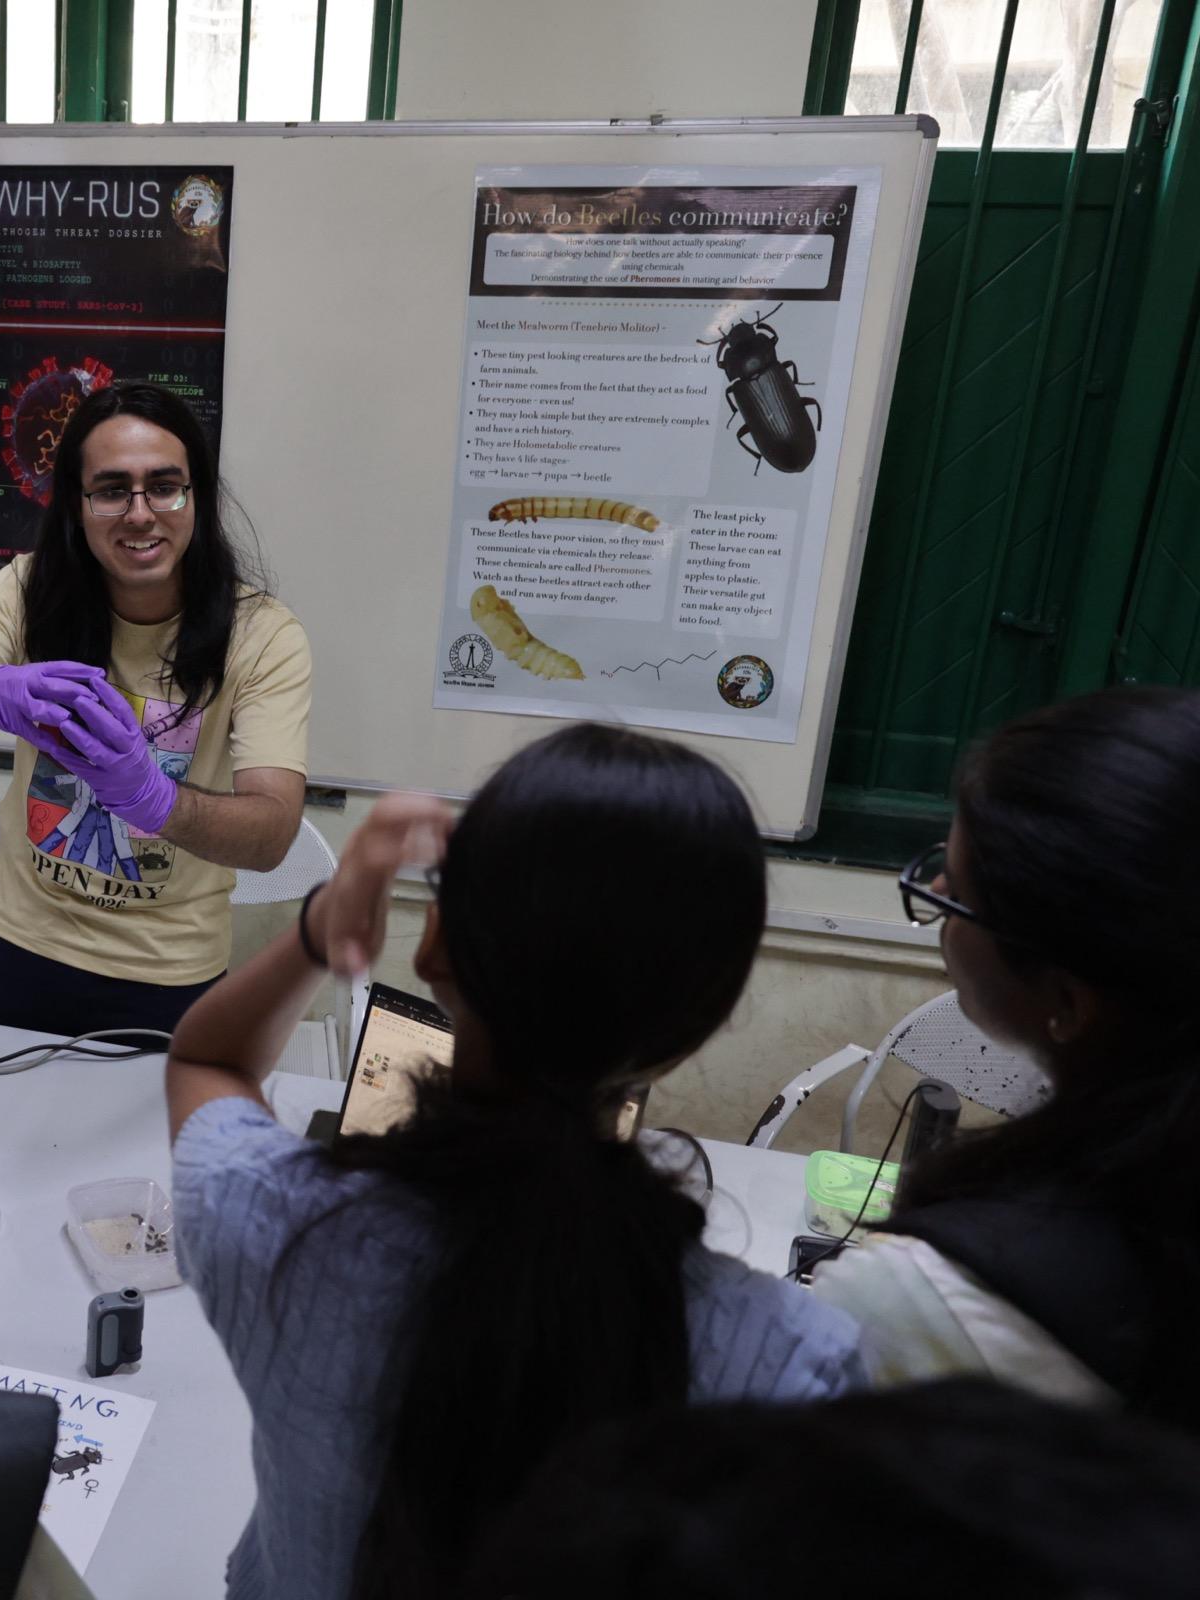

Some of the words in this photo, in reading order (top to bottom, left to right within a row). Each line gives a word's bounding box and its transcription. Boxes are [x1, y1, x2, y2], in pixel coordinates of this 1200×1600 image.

[482, 203, 537, 226] How
[543, 204, 572, 226] do
[578, 203, 662, 226] Beetles
[668, 203, 848, 226] communicate?
[55, 228, 100, 238] THREAT
[109, 229, 162, 239] DOSSIER
[32, 260, 81, 269] BIOSAFETY
[6, 274, 54, 283] PATHOGENS
[59, 275, 92, 284] LOGGED
[477, 319, 499, 329] Meet
[500, 320, 516, 330] the
[518, 320, 568, 330] Mealworm
[570, 321, 618, 332] (Tenebrio
[620, 322, 660, 332] Molitor)
[482, 348, 507, 358] These
[508, 351, 524, 362] tiny
[526, 351, 545, 362] pest
[547, 351, 581, 362] looking
[643, 353, 658, 362] the
[660, 353, 698, 363] bedrock
[479, 364, 500, 373] farm
[480, 379, 502, 388] Their
[559, 381, 581, 391] from
[583, 381, 597, 391] the
[599, 382, 615, 391] fact
[617, 383, 635, 392] that
[637, 383, 655, 393] they
[685, 384, 707, 395] food
[477, 393, 490, 402] for
[561, 396, 574, 405] us!
[478, 408, 497, 417] They
[499, 412, 517, 421] may
[519, 410, 538, 419] look
[540, 410, 569, 423] simple
[571, 411, 585, 421] but
[587, 412, 606, 424] they
[624, 414, 668, 424] extremely
[670, 416, 710, 428] complex
[474, 423, 491, 432] and
[492, 424, 512, 433] have
[521, 425, 539, 434] rich
[475, 437, 494, 449] They
[512, 439, 577, 450] Holometabolic
[578, 443, 620, 452] creatures
[474, 452, 493, 461] They
[495, 453, 515, 462] have
[524, 454, 538, 463] life
[469, 469, 485, 479] egg
[500, 468, 529, 478] larvae
[544, 472, 568, 482] pupa
[583, 471, 611, 482] beetle
[694, 509, 711, 519] The
[714, 510, 737, 521] least
[738, 512, 766, 525] picky
[472, 527, 496, 537] These
[498, 528, 529, 538] Beetles
[531, 530, 552, 540] have
[553, 534, 576, 544] poor
[620, 535, 639, 547] they
[690, 527, 716, 536] eater
[729, 528, 745, 537] the
[747, 532, 777, 540] room:
[476, 543, 536, 554] communicate
[537, 546, 550, 555] via
[552, 547, 596, 558] chemicals
[598, 549, 617, 561] they
[690, 540, 716, 551] These
[717, 543, 746, 553] larvae
[476, 556, 501, 566] These
[502, 558, 546, 569] chemicals
[564, 562, 592, 572] called
[686, 556, 726, 569] anything
[727, 558, 750, 568] from
[472, 570, 501, 581] Watch
[514, 573, 537, 583] these
[538, 575, 570, 585] beetles
[571, 578, 600, 588] attract
[602, 579, 624, 588] each
[625, 580, 650, 590] other
[500, 587, 517, 596] and
[535, 592, 558, 602] away
[560, 591, 582, 601] from
[32, 851, 92, 892] PEN
[100, 879, 166, 900] DAY
[58, 1420, 84, 1430] IND
